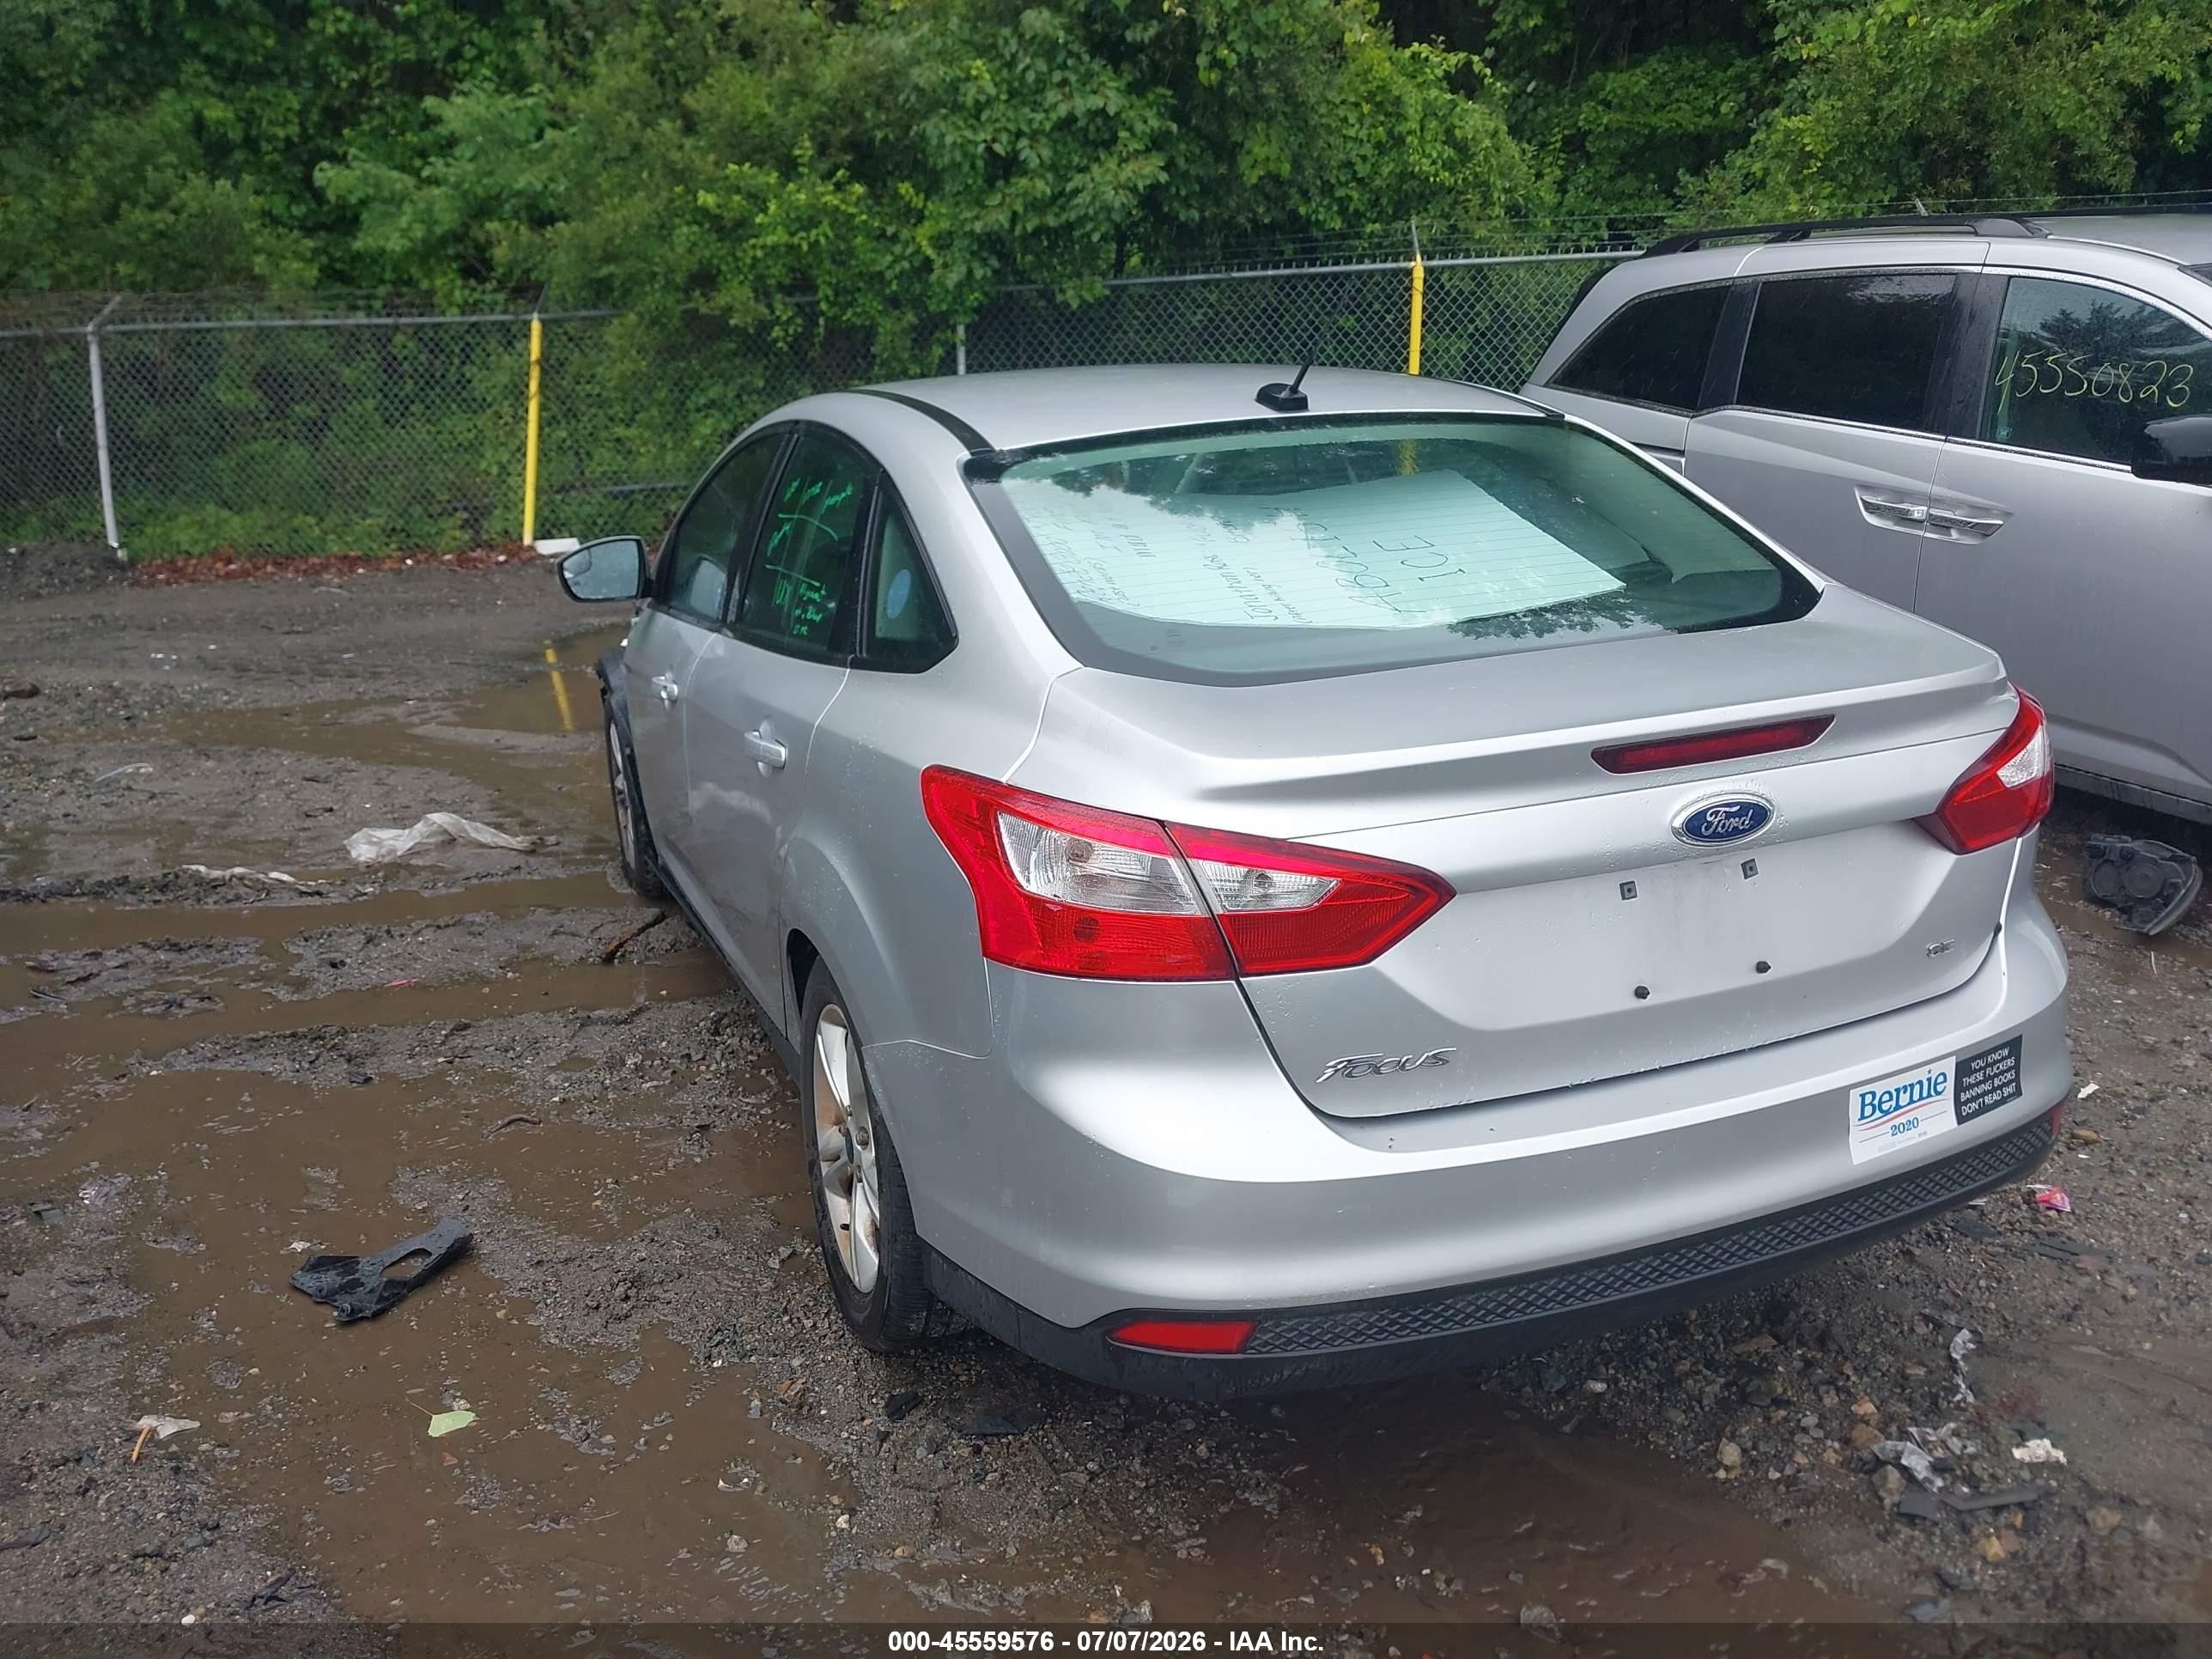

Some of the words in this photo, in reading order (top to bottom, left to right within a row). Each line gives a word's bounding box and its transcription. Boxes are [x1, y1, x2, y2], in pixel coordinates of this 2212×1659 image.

[1995, 349, 2194, 415] 45550823
[1371, 535, 1466, 581] ICE
[1217, 572, 1279, 621] Jonathan
[1701, 805, 1753, 836] Ford
[1962, 1073, 1985, 1087] THESE
[1985, 1057, 2015, 1076] FUCKERS
[1971, 1054, 1988, 1070] YOU
[1987, 1046, 2011, 1064] KNOW
[1857, 1070, 1948, 1121] Bernie
[1960, 1079, 1993, 1102] BANNING
[1993, 1069, 2016, 1087] BOOKS
[1961, 1097, 1984, 1115] DON'T
[1984, 1089, 2002, 1106] READ
[2002, 1082, 2017, 1099] SHIT
[1890, 1117, 1919, 1137] 2020
